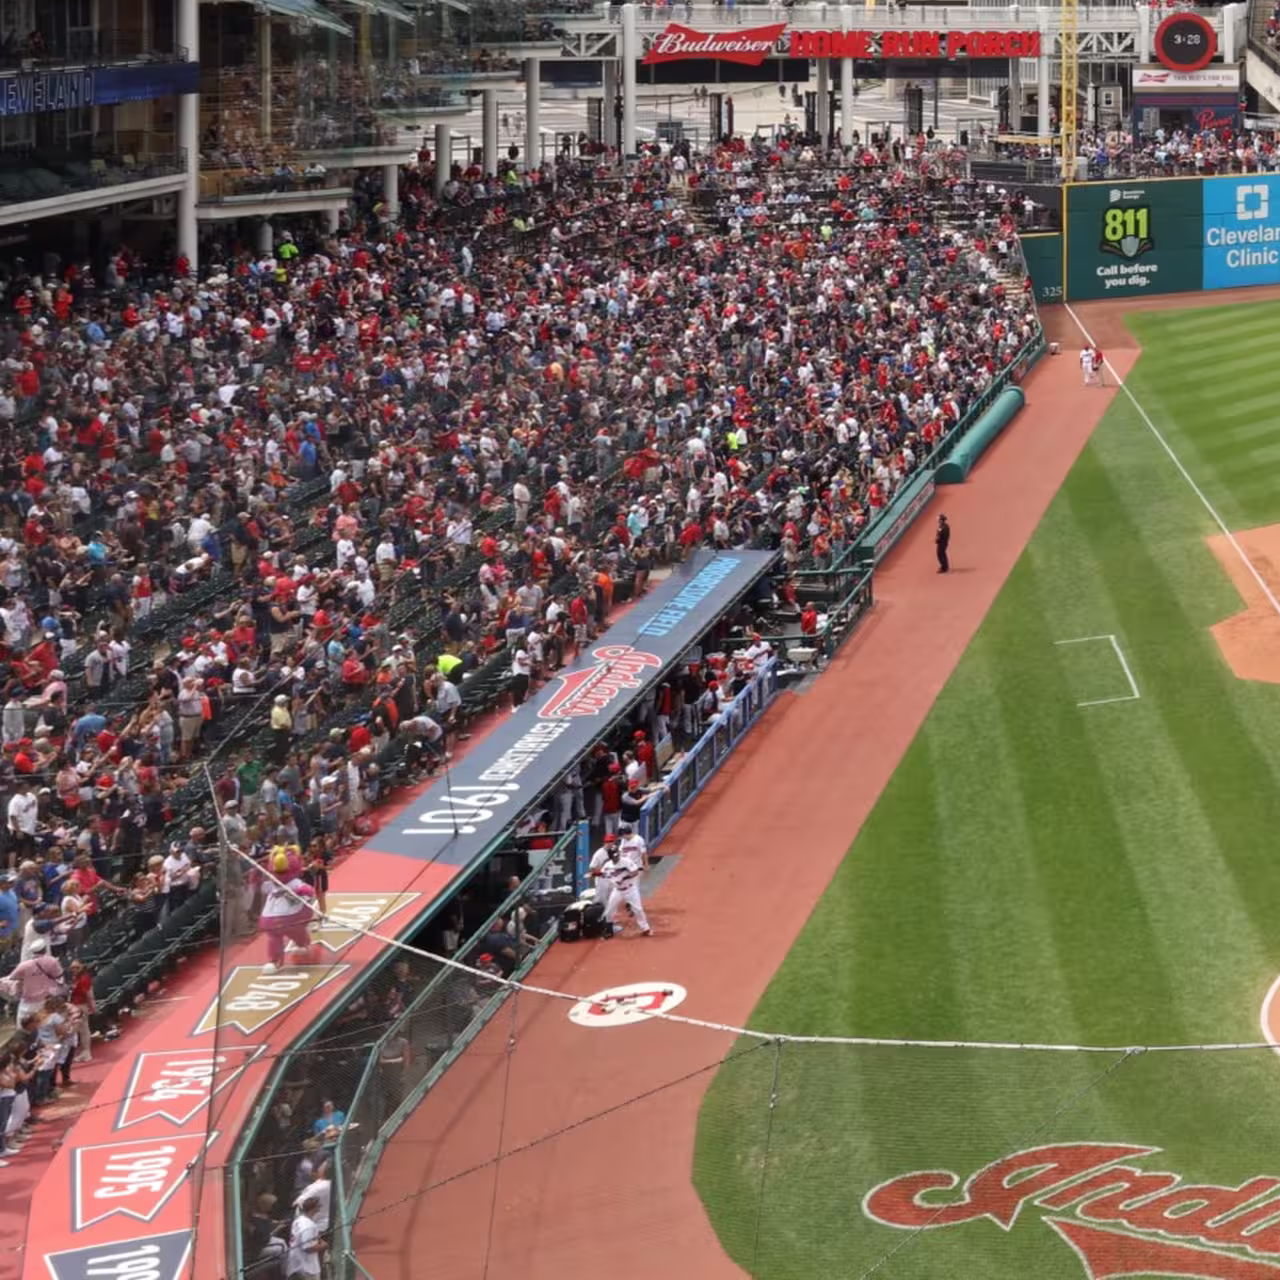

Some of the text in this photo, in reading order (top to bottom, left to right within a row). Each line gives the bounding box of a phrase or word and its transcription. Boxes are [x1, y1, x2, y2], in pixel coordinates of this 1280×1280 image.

[655, 29, 1041, 59] Budweiser HOME RUN PORCH
[1104, 208, 1149, 241] 811
[1096, 263, 1158, 276] Call before
[1226, 247, 1280, 269] Clinic
[1042, 286, 1063, 298] 325
[1104, 275, 1151, 289] you dig.
[402, 783, 519, 836] 1901
[225, 971, 309, 1012] 1948
[94, 1145, 177, 1199] 1995
